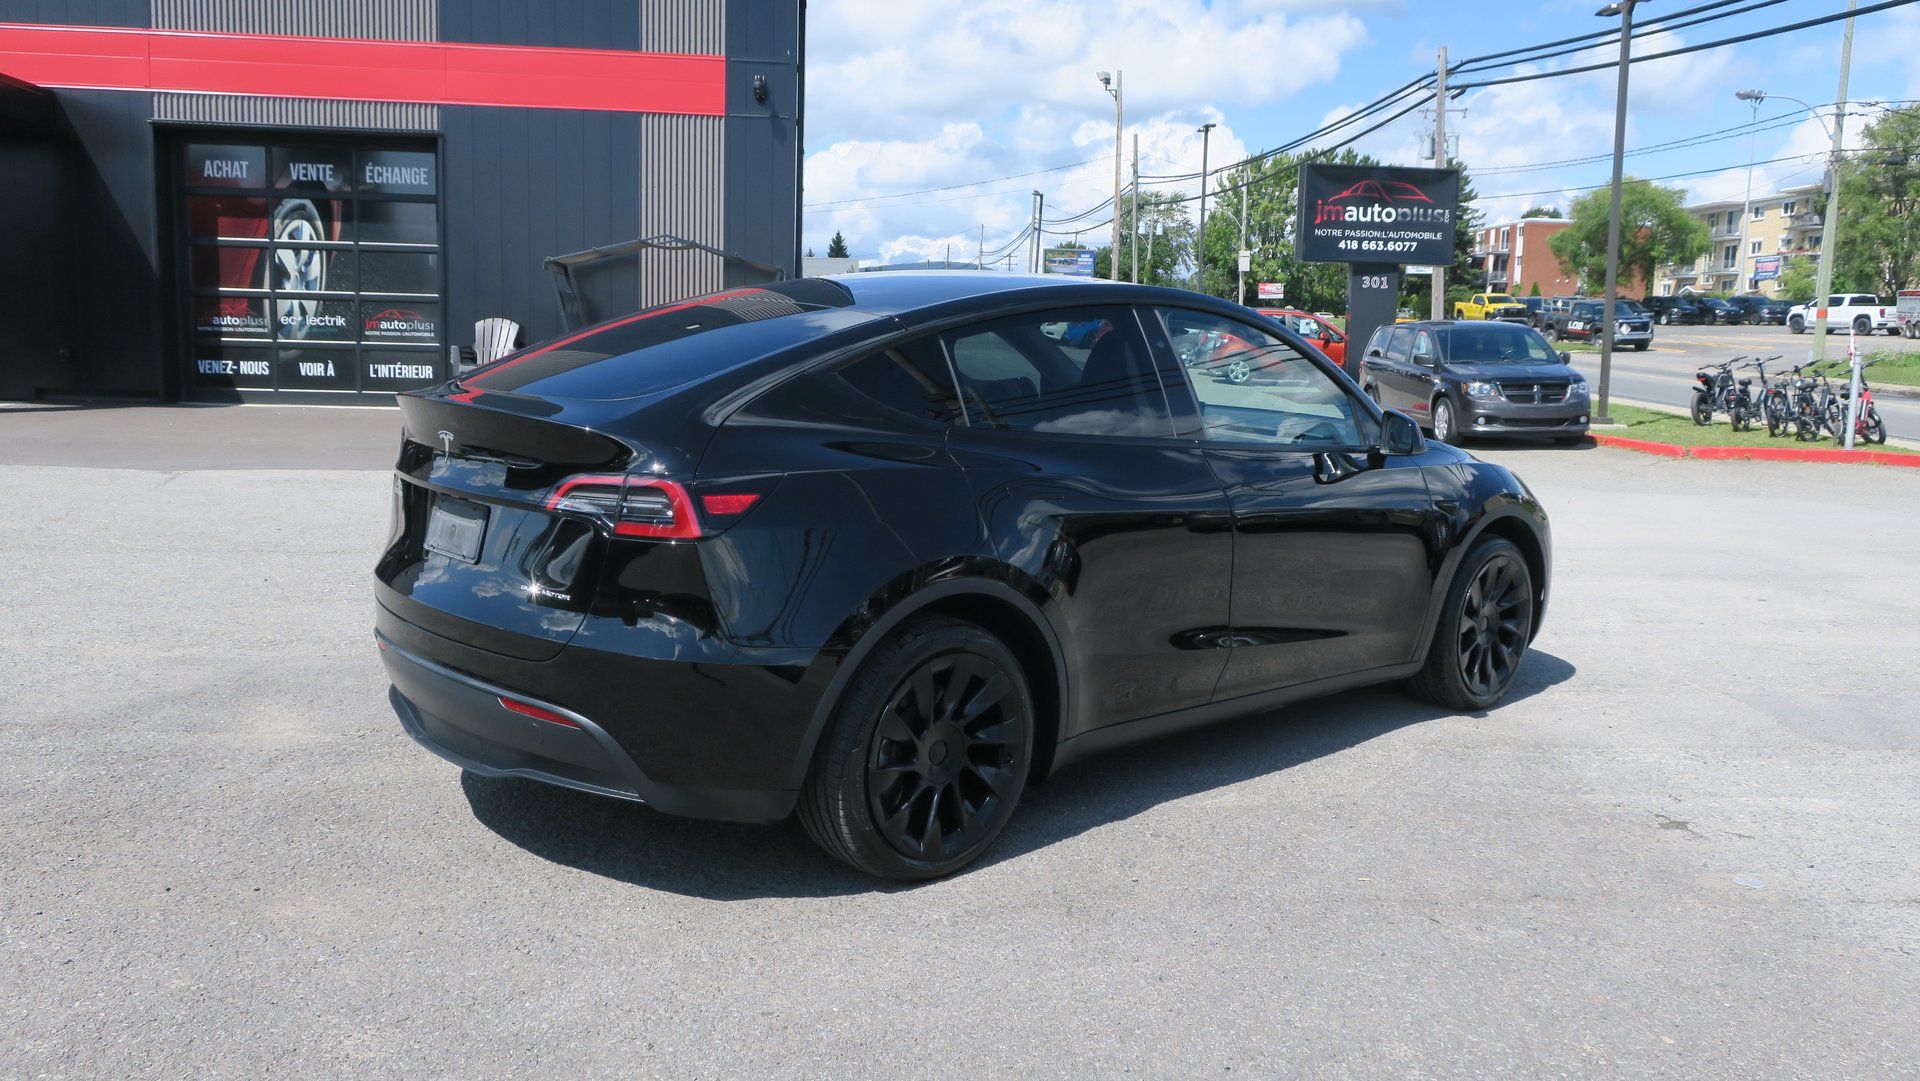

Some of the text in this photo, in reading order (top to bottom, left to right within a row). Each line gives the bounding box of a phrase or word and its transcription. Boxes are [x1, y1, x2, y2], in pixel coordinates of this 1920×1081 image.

[204, 159, 248, 179] ACHAT
[290, 163, 334, 182] VENTE
[365, 163, 429, 185] ÉCHANGE
[1314, 200, 1444, 225] jmautoplus
[1315, 229, 1342, 237] NOTRE
[1338, 240, 1418, 252] 418 663.6077
[1362, 275, 1389, 289] 301
[299, 360, 335, 377] VOIR À
[369, 361, 433, 379] L'INTÉRIEUR
